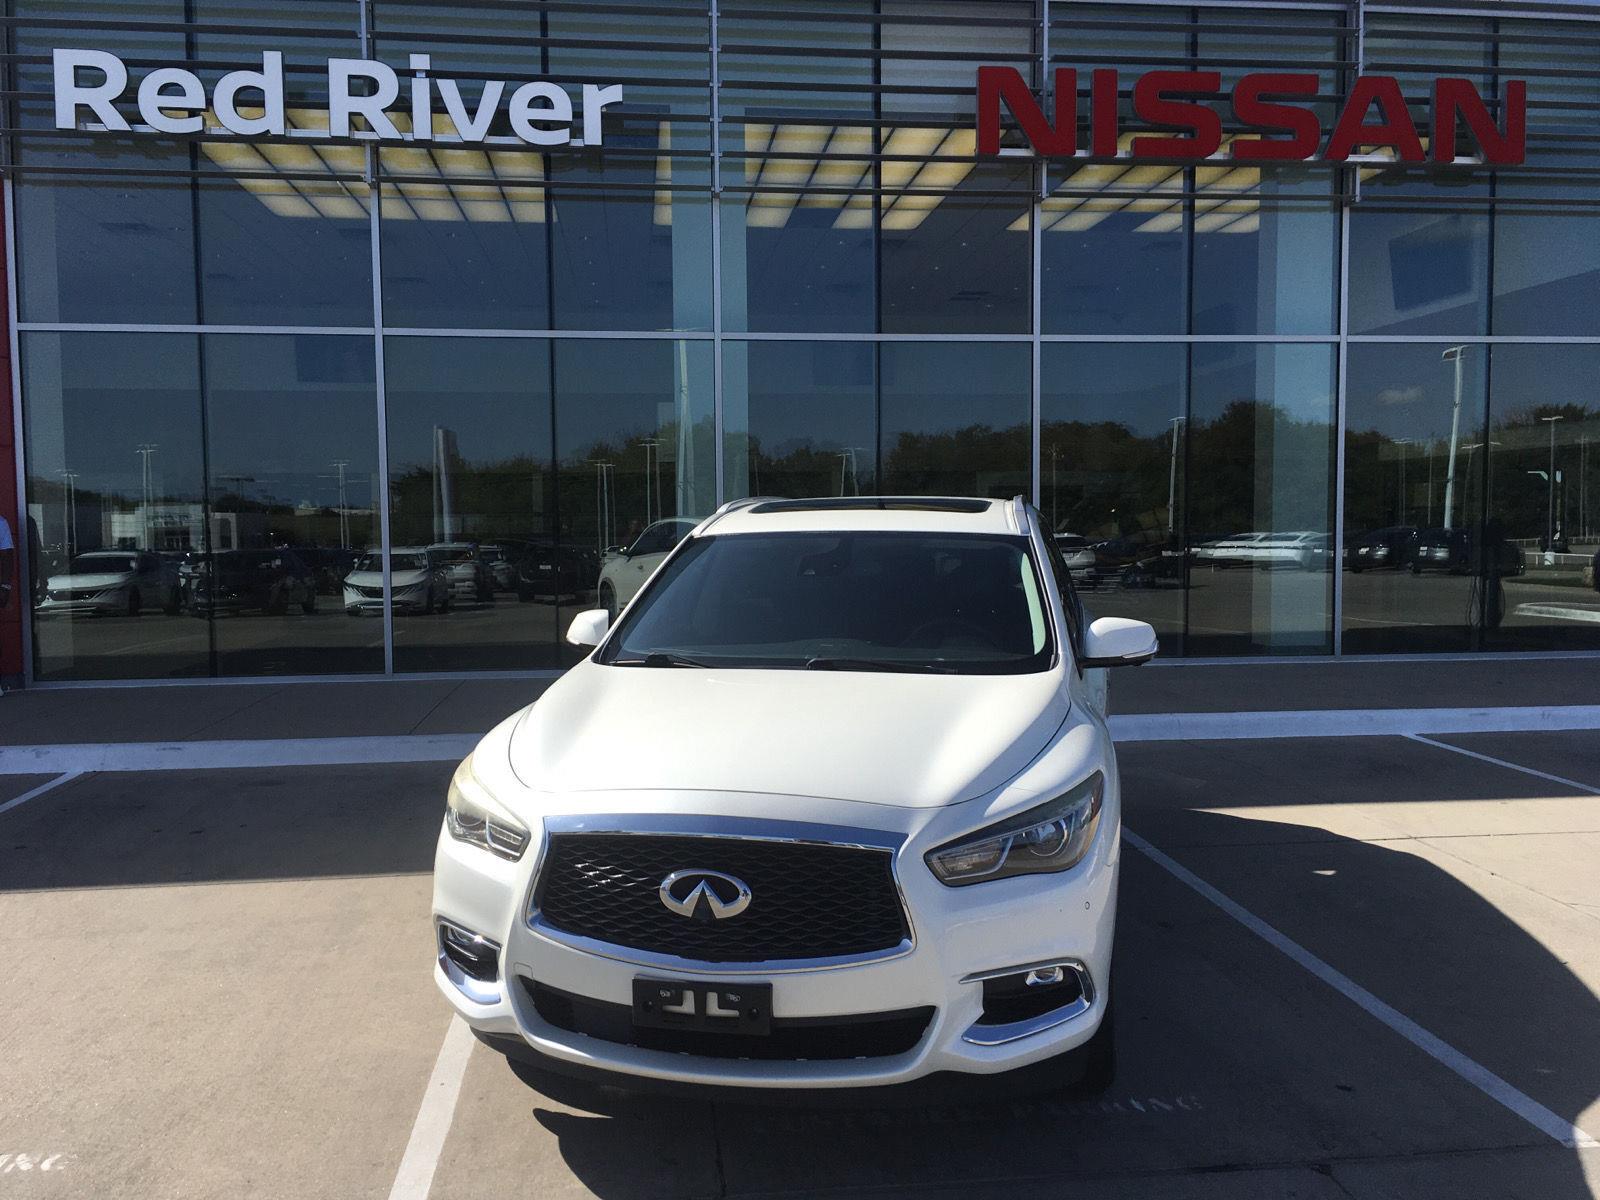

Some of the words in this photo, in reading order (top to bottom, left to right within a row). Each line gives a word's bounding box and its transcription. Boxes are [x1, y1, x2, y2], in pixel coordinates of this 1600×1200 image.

[52, 48, 286, 136] Red
[328, 53, 622, 145] River
[975, 65, 1526, 164] NISSAN
